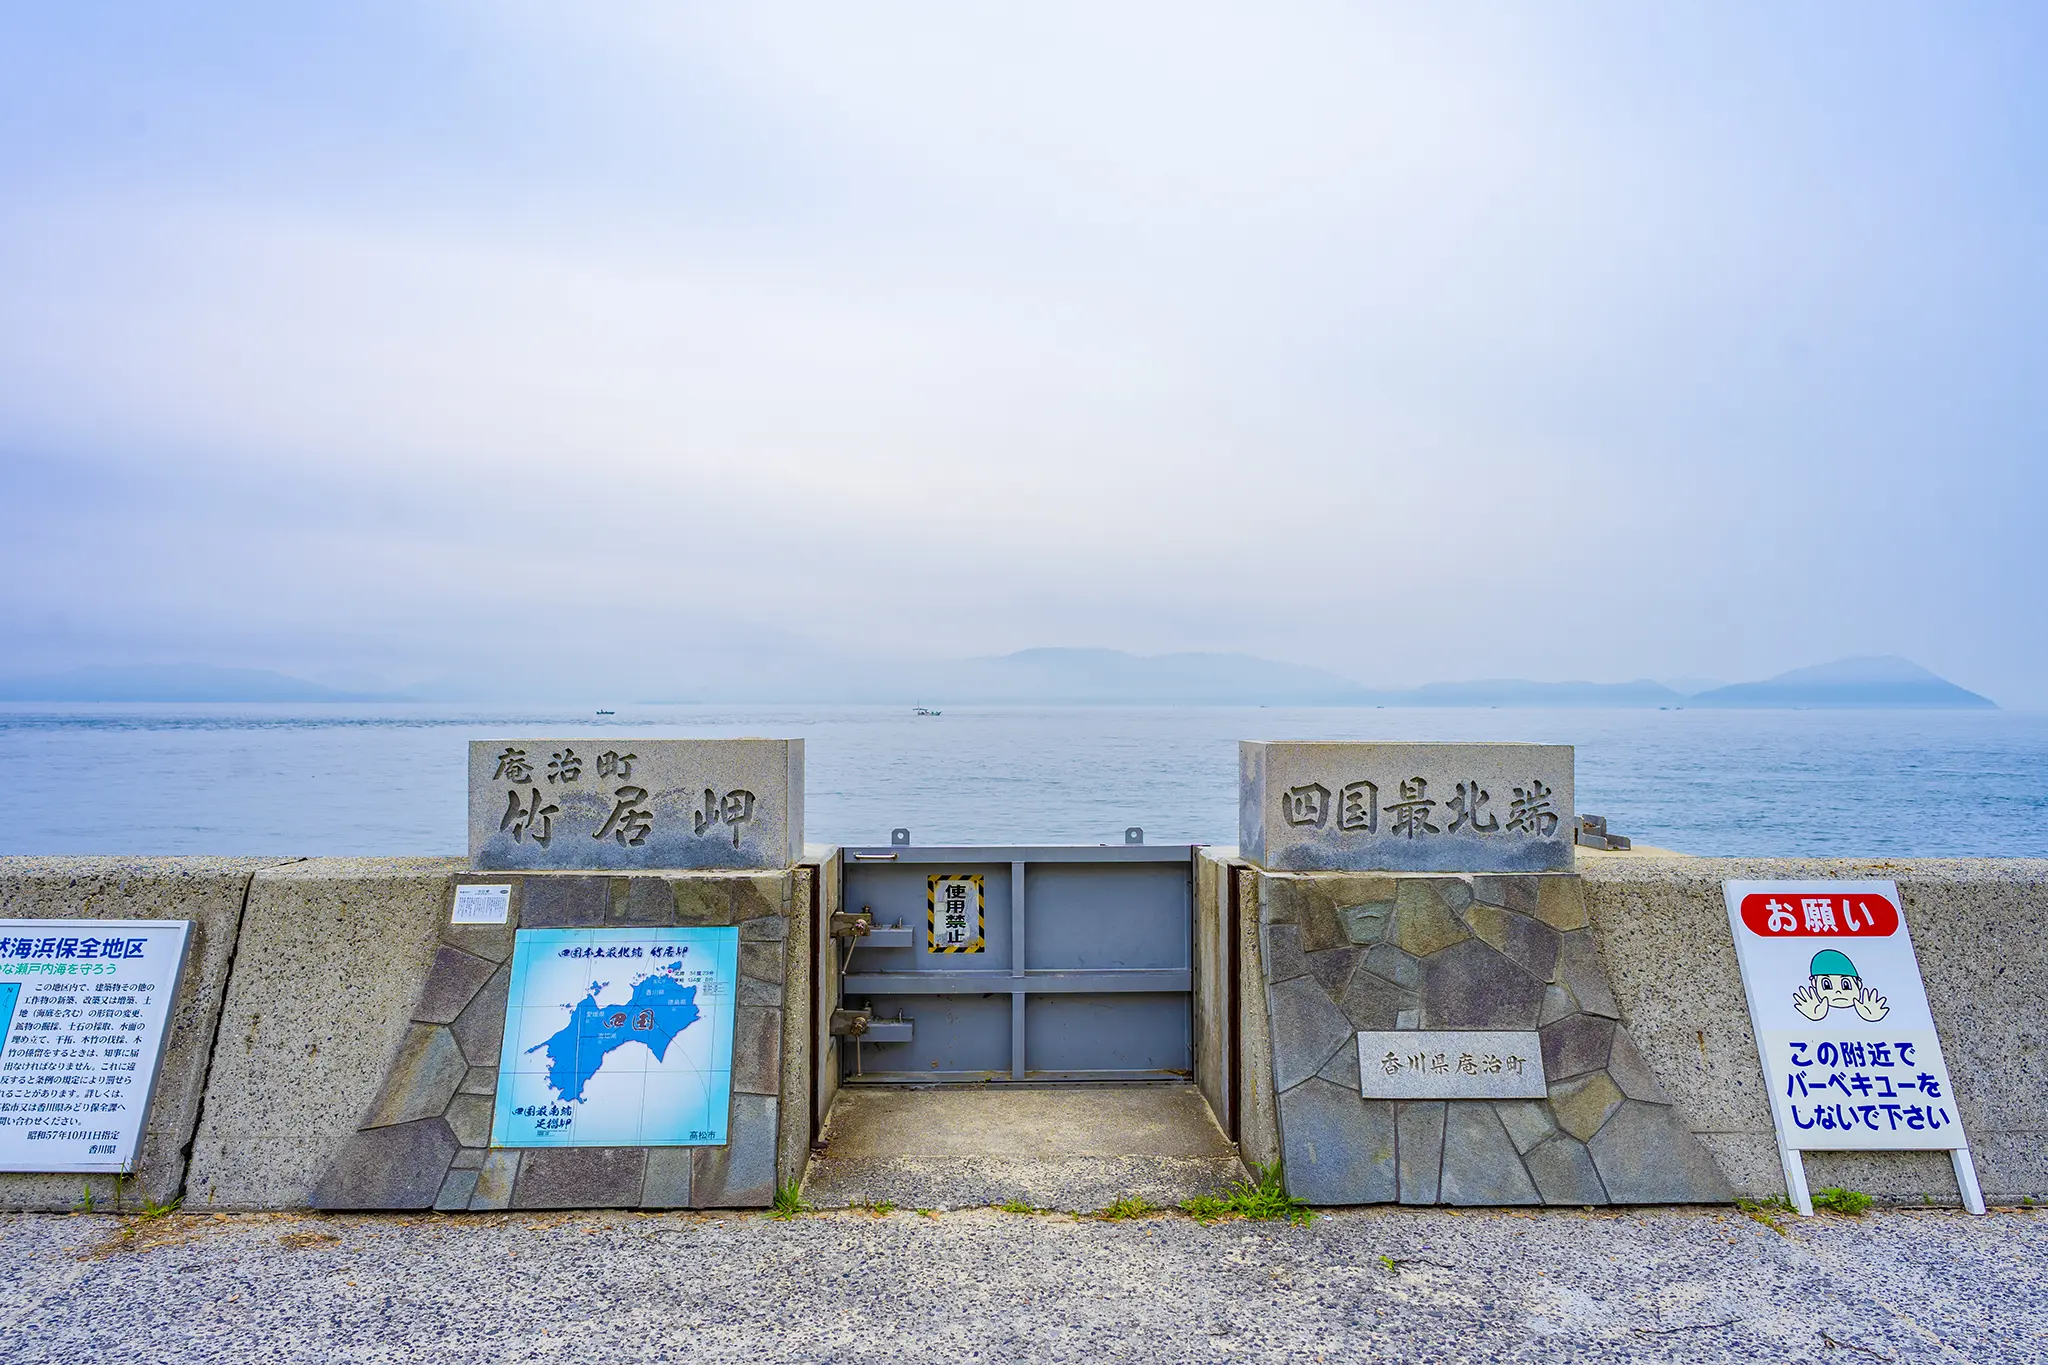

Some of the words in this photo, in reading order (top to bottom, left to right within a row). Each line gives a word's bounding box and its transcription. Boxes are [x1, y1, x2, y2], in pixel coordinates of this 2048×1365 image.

[493, 747, 638, 785] 庵治町
[499, 785, 756, 850] 竹居岬
[1281, 776, 1559, 840] 四国最北端
[945, 884, 967, 943] 使用禁止
[1765, 898, 1875, 933] お願い
[0, 962, 117, 976] な瀬戸内海を守ろう
[603, 1008, 654, 1031] 四国
[1379, 1052, 1527, 1077] 香川県庵治町
[1789, 1042, 1916, 1068] この附近で
[1786, 1072, 1942, 1098] バーベキューを
[0, 1102, 126, 1112] 松市又は香川県みどり保全課へ
[1791, 1104, 1950, 1131] しないで下さい
[689, 1130, 716, 1141] 高松市
[89, 1144, 117, 1154] 香川県
